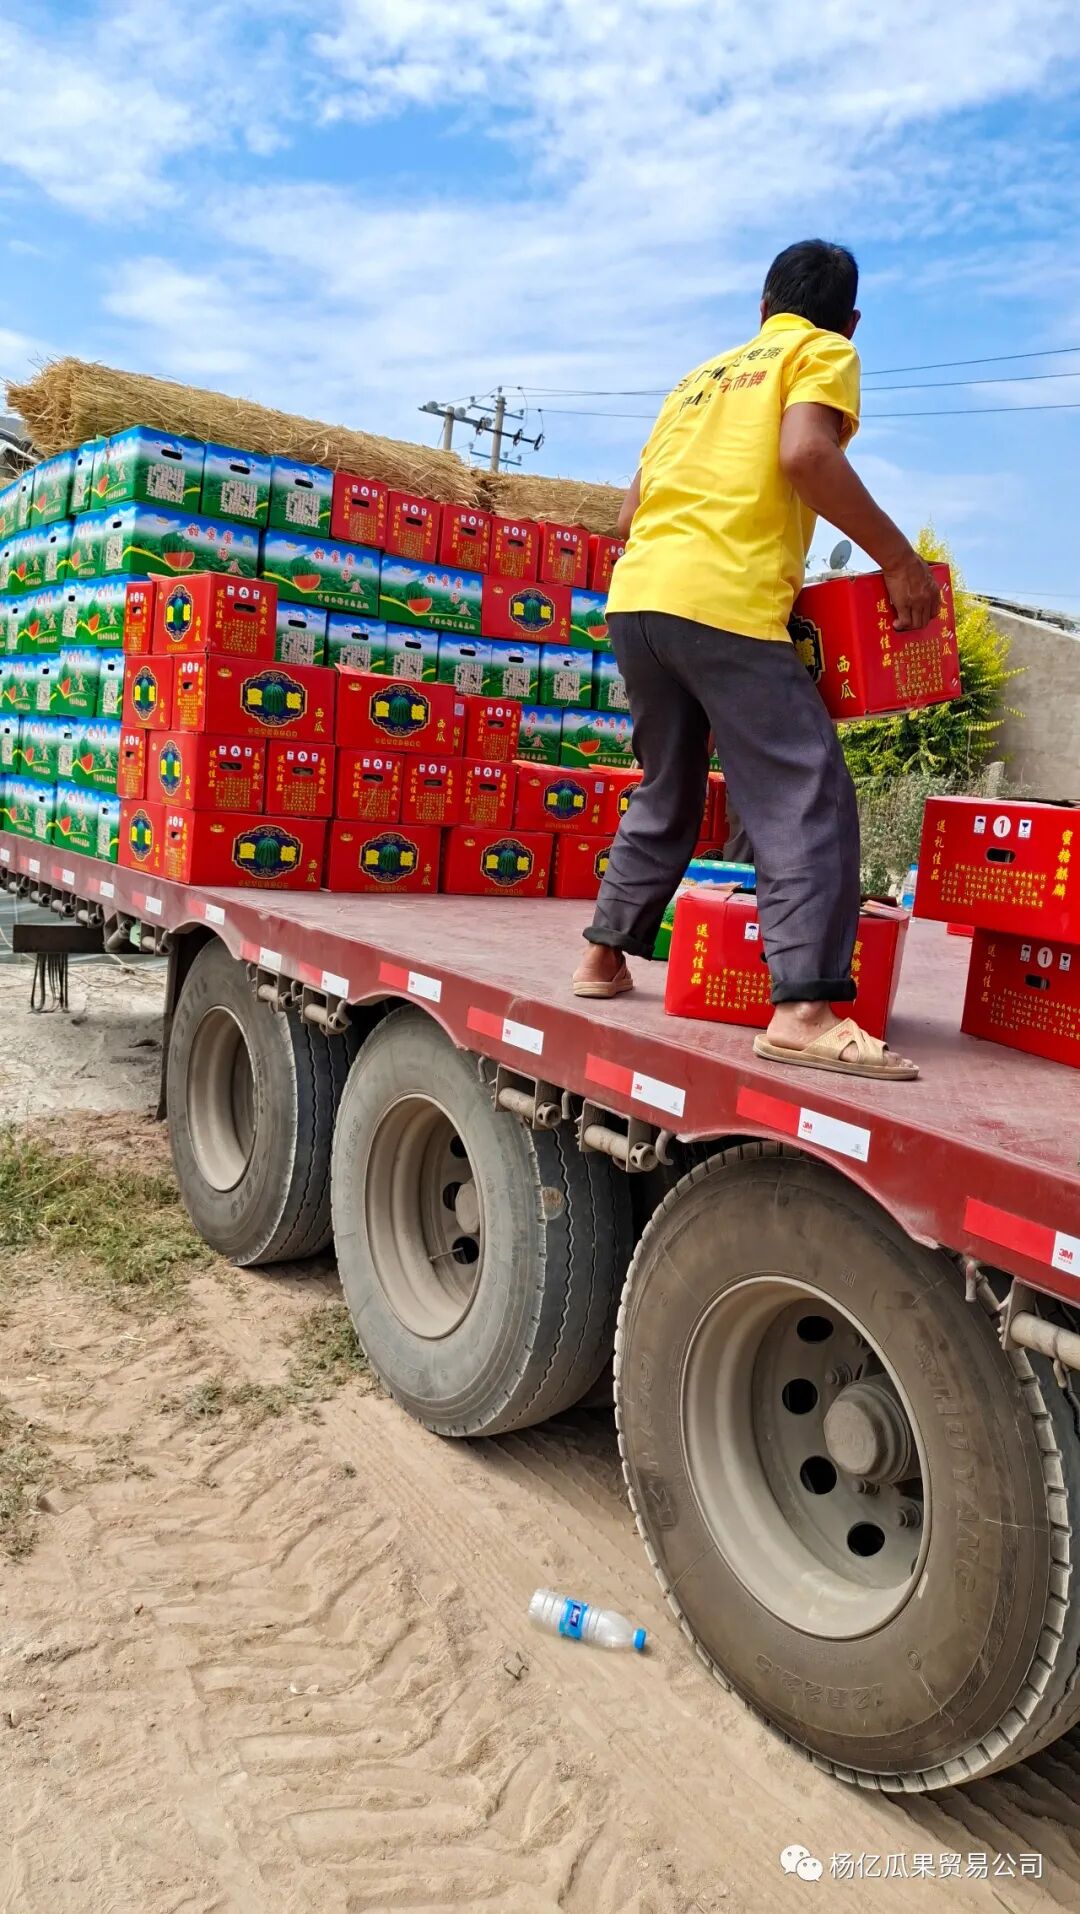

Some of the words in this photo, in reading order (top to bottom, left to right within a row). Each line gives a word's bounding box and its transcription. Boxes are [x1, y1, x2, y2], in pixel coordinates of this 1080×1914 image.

[877, 598, 891, 667] 送礼佳品
[837, 655, 856, 699] 西瓜
[931, 819, 946, 880] 送礼佳品
[998, 819, 1006, 834] 1
[691, 923, 709, 984] 送礼佳品
[1058, 1248, 1074, 1260] 3M
